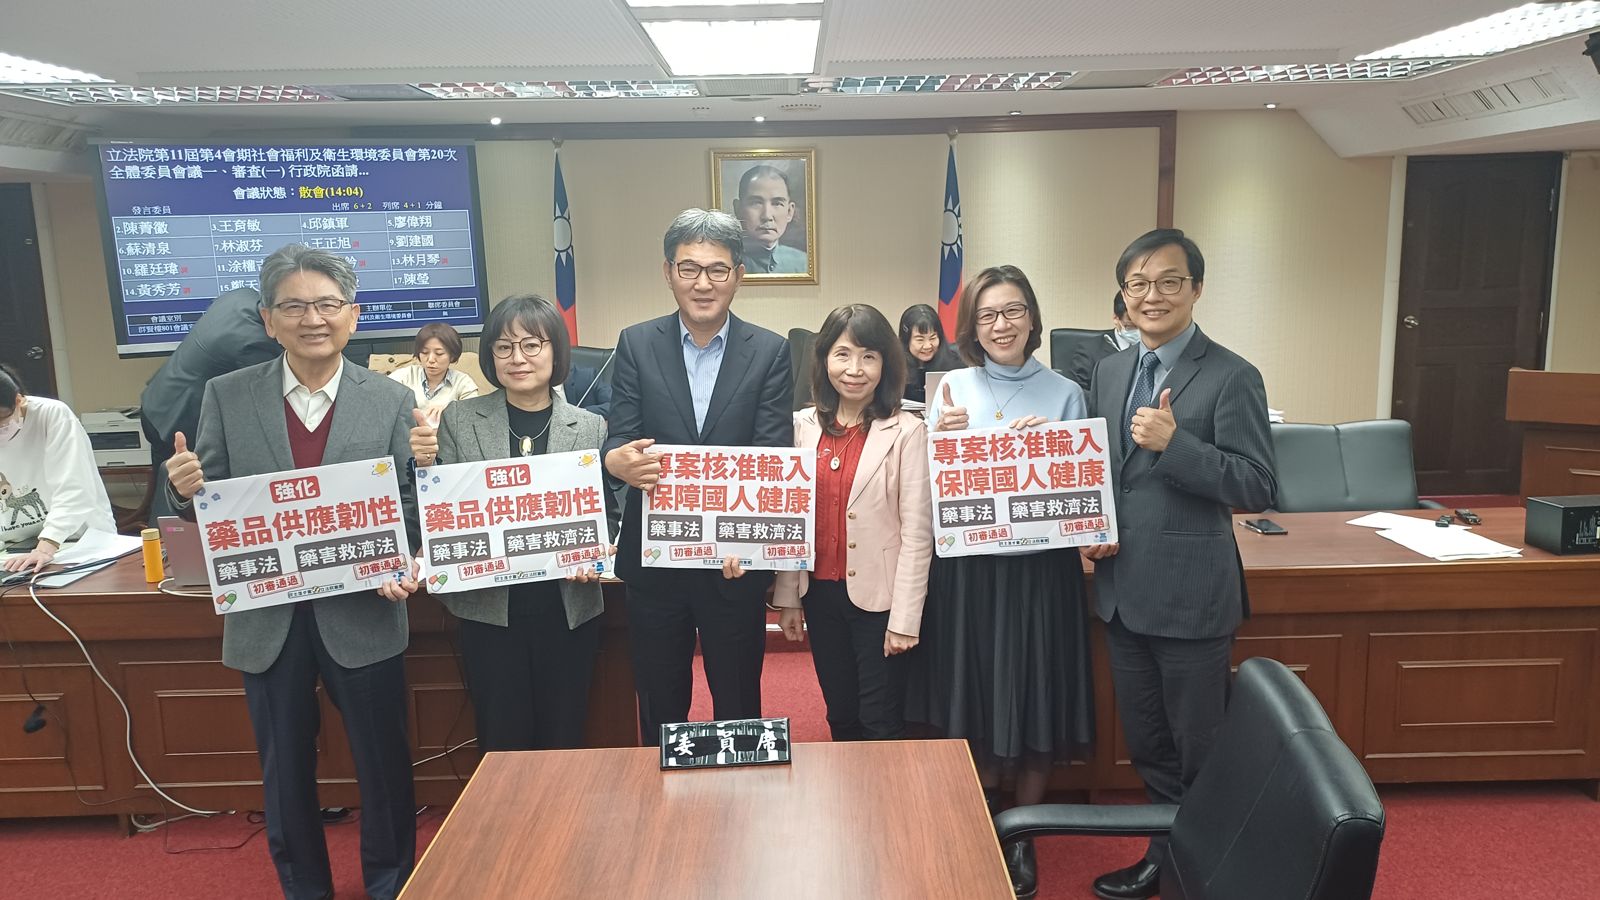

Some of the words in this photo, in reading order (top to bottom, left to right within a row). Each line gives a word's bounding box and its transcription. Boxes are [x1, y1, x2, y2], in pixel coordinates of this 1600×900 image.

[106, 147, 458, 163] 立法院第11屆第4會期社會福利及衛生環境委員會第20次
[332, 202, 350, 211] 出席
[933, 428, 1103, 466] 專案核准輸入
[489, 467, 528, 487] 強化
[934, 458, 1105, 498] 保障國人健康
[274, 479, 317, 502] 強化
[647, 483, 812, 514] 保障國人健康
[424, 486, 602, 533] 藥品供應韌性
[941, 503, 994, 524] 藥事法
[1011, 496, 1100, 519] 藥害救濟法
[204, 495, 401, 552] 藥品供應韌性
[650, 519, 700, 538] 藥事法
[718, 521, 803, 541] 藥害救濟法
[1063, 519, 1105, 533] 初審通過
[432, 540, 489, 562] 藥事法
[506, 526, 596, 553] 藥害救濟法
[968, 528, 1009, 542] 初審通過
[217, 555, 280, 582] 藥事法
[297, 537, 396, 568] 藥害救濟法
[560, 547, 601, 565] 初審通過
[674, 545, 714, 558] 初審通過
[767, 544, 807, 557] 初審通過
[358, 557, 402, 577] 初審通過
[463, 560, 505, 577] 初審通過
[252, 575, 299, 594] 初審通過
[674, 728, 778, 756] 委員席
